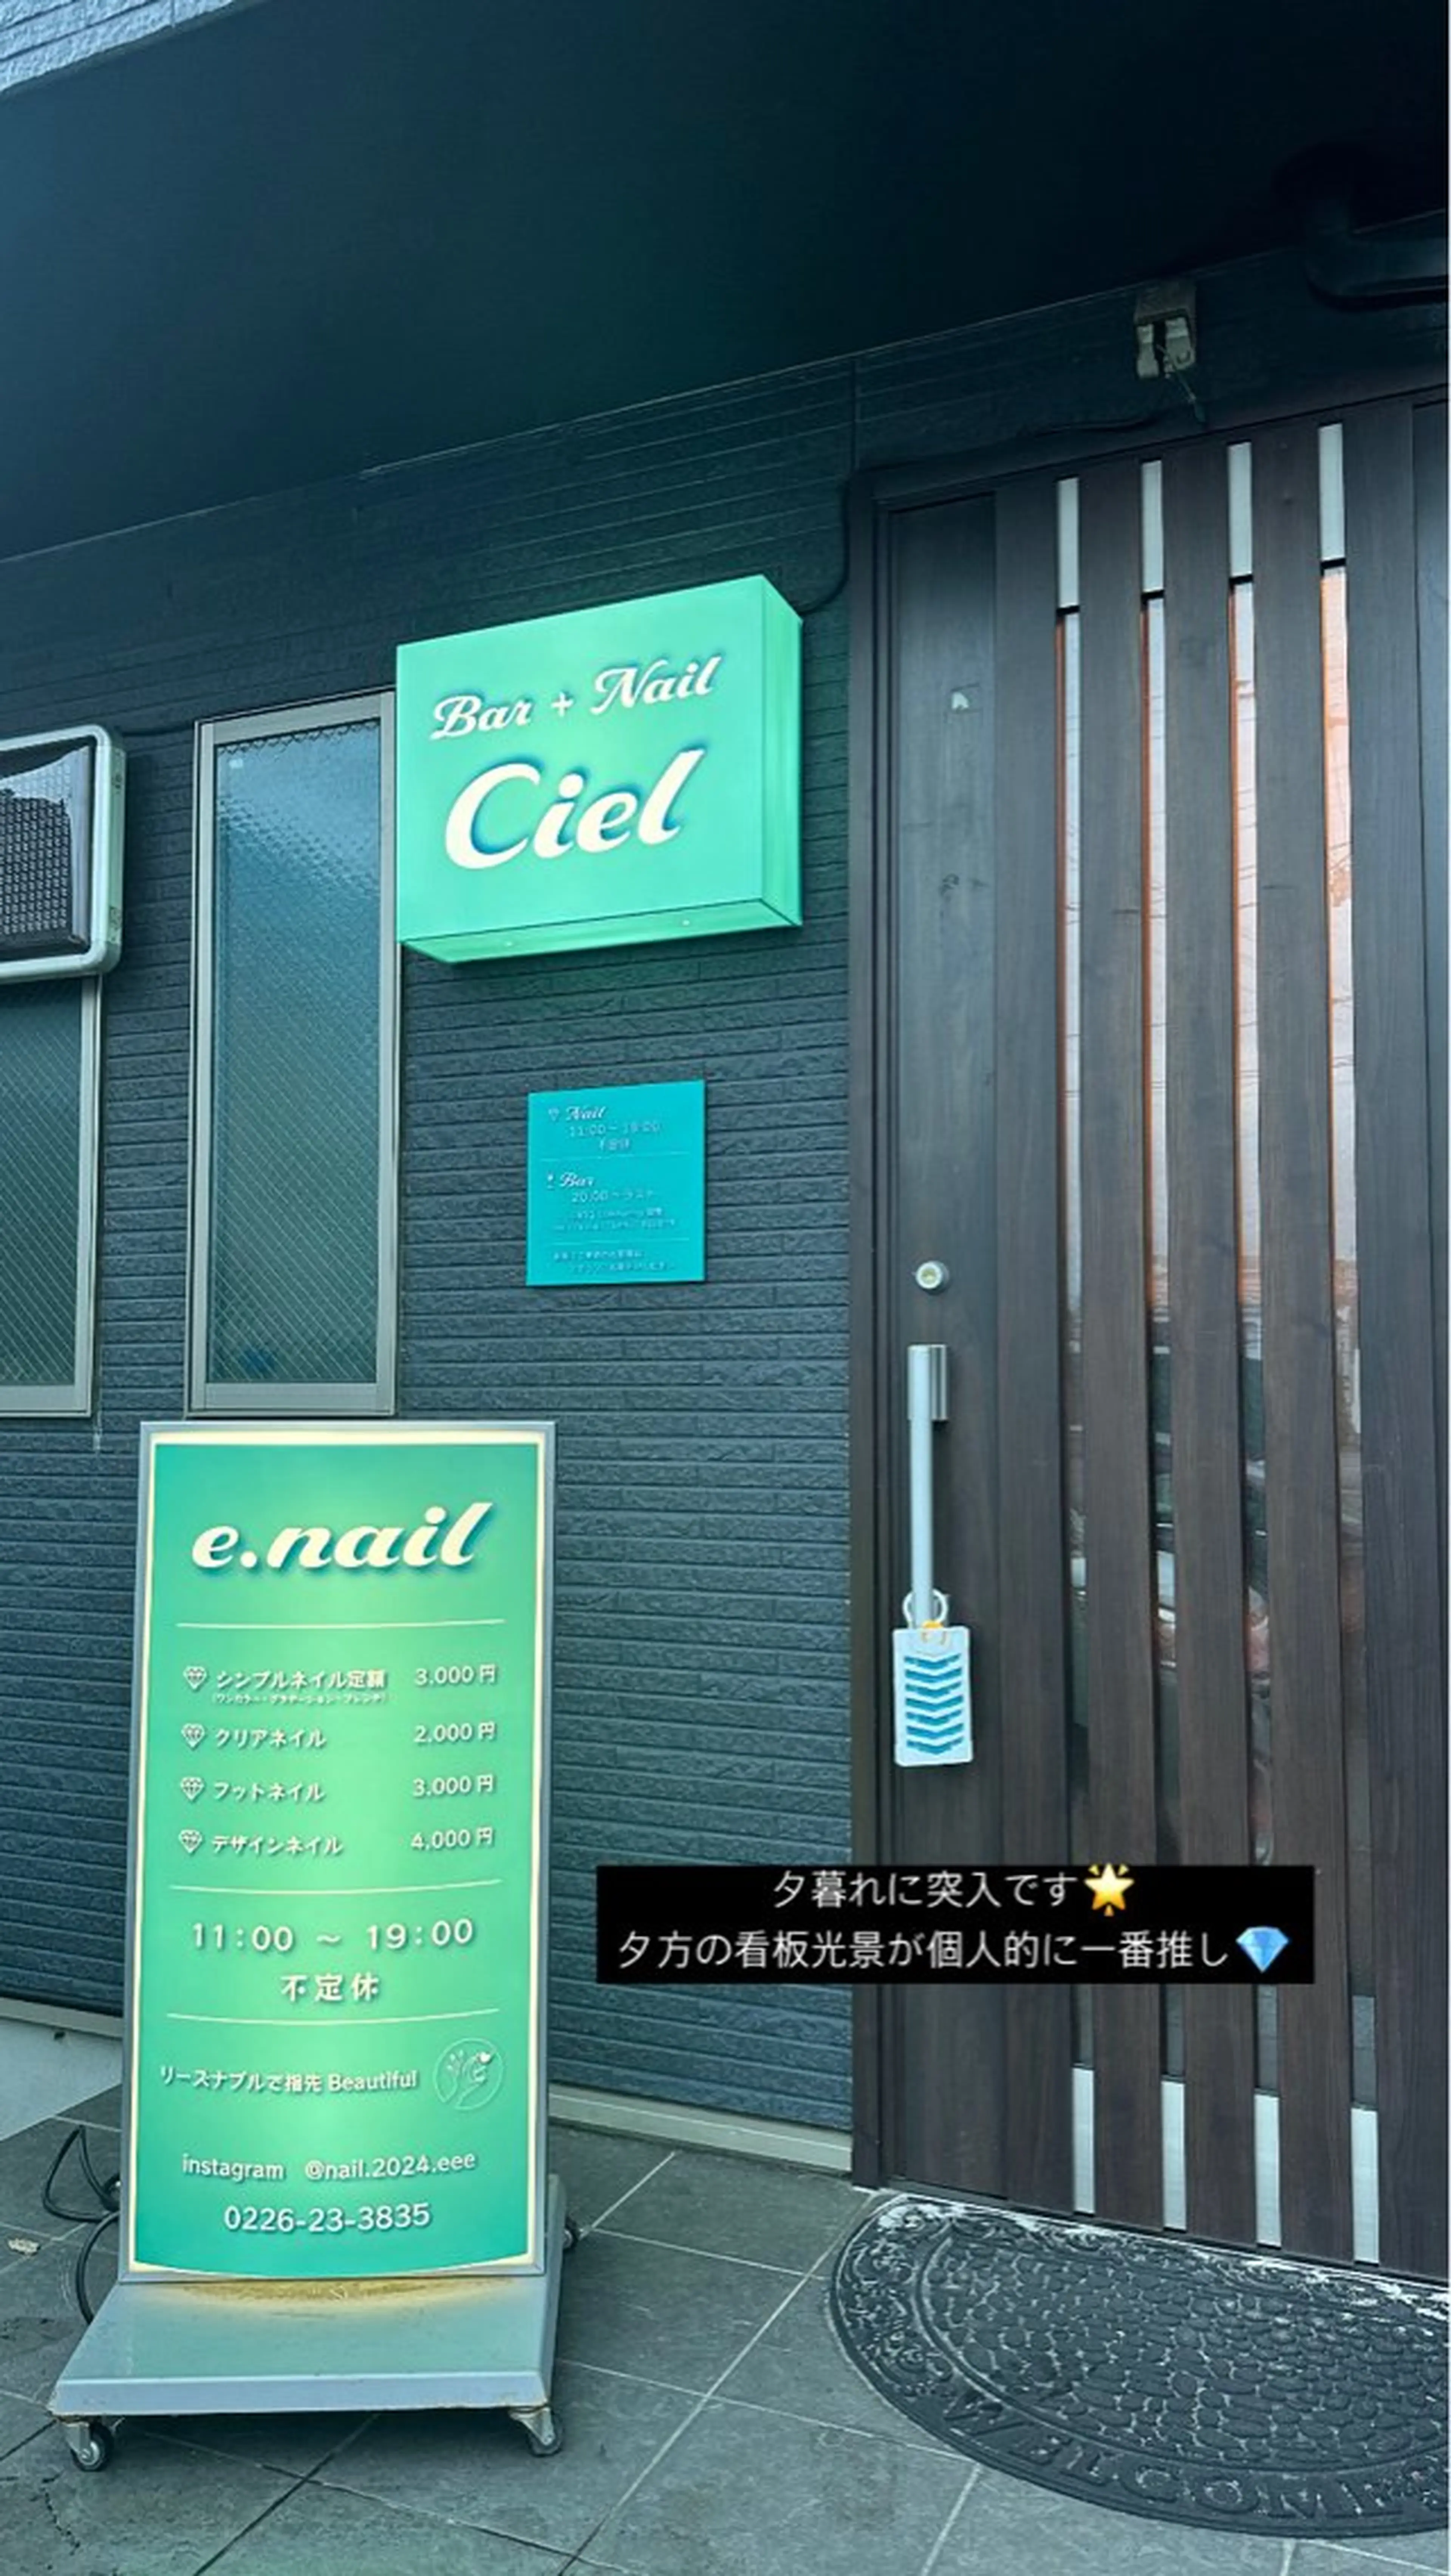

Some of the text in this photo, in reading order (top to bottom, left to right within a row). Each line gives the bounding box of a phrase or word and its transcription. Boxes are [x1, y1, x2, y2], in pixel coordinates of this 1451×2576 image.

[431, 696, 531, 739] Bar
[591, 657, 721, 714] Nail
[446, 751, 703, 868] Ciel
[565, 1106, 606, 1121] Nail
[559, 1172, 594, 1187] Bar
[192, 1503, 492, 1567] e.nail
[217, 1670, 385, 1689] シンプルネイル定額
[216, 1729, 325, 1746] クリアネイル
[214, 1782, 323, 1800] フットネイル
[212, 1836, 342, 1853] デザインネイル
[194, 1923, 292, 1950] 11:00
[368, 1919, 472, 1949] 19:00
[282, 1972, 378, 2001] 不定休
[328, 2070, 416, 2090] Beautiful
[183, 2154, 475, 2181] instagram @nail.2024.eee
[224, 2203, 429, 2231] 0226-23-3835
